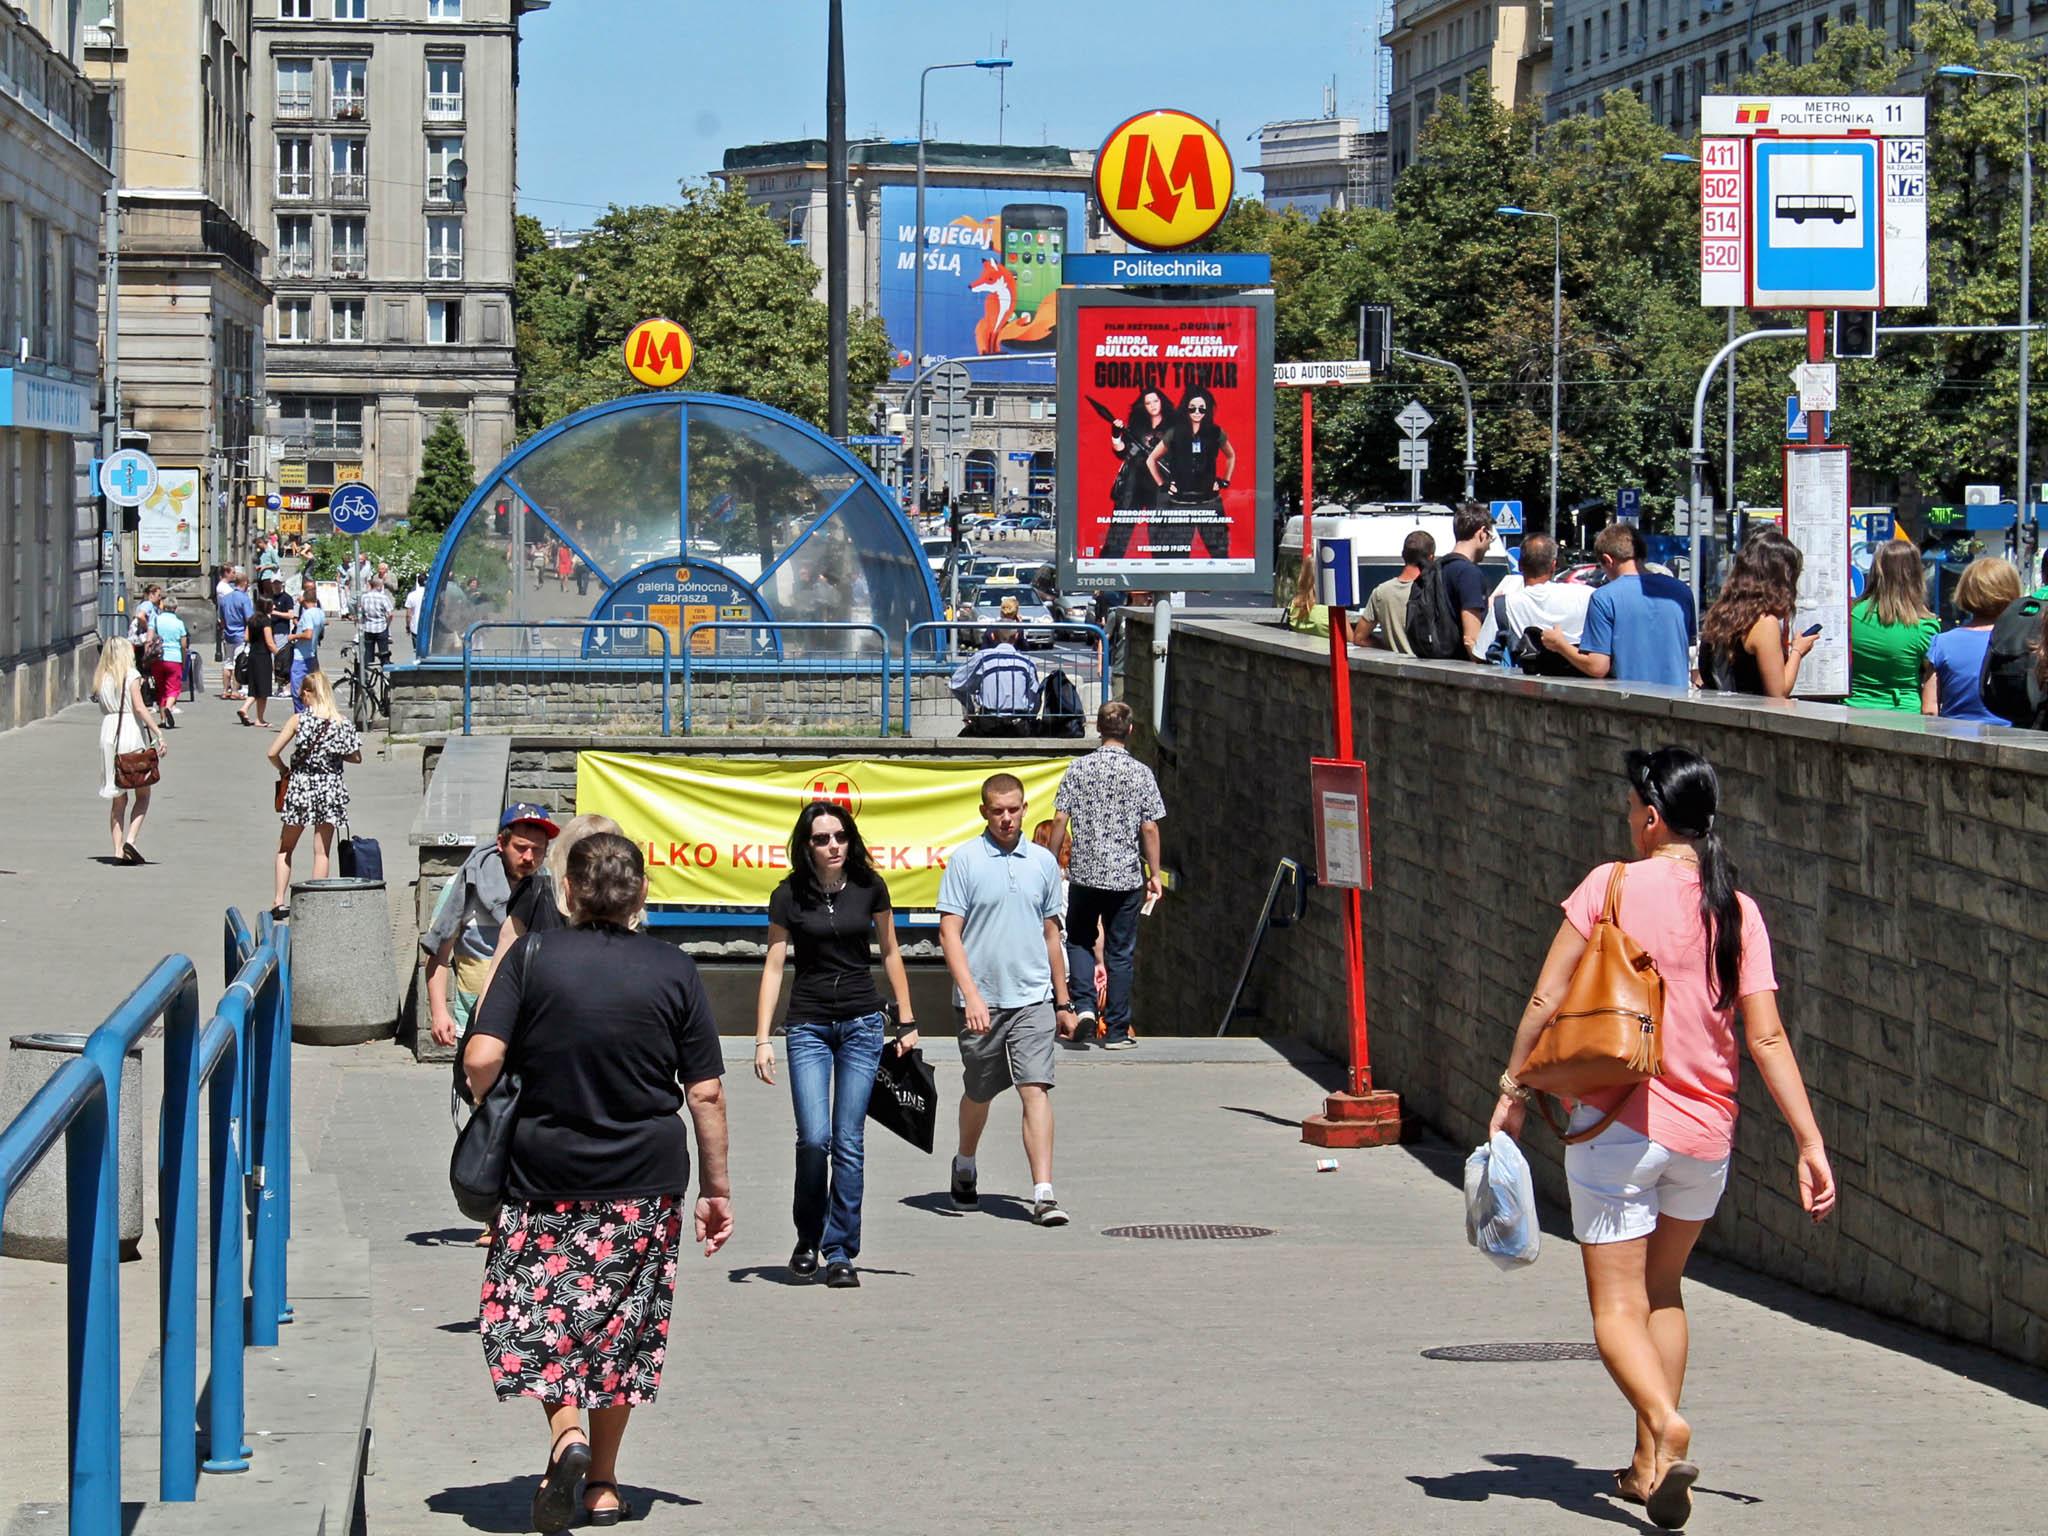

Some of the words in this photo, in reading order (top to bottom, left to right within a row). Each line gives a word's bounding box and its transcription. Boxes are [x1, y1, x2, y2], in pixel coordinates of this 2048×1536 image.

[1805, 102, 1850, 111] METRO
[1885, 105, 1902, 122] 11
[1781, 114, 1874, 124] POLITECHNIKA
[1706, 145, 1734, 166] 411
[1887, 142, 1923, 163] N25
[1705, 178, 1737, 198] 502
[1888, 175, 1923, 196] N75
[1705, 212, 1736, 232] 514
[1705, 246, 1737, 266] 520
[1113, 260, 1222, 277] Politechnika
[1106, 336, 1148, 345] SANDRA
[1180, 336, 1222, 345] MELISSA
[1095, 345, 1158, 357] BULLOCK
[1165, 345, 1238, 357] McCARTHY
[1173, 362, 1237, 388] TOWAR
[1273, 366, 1296, 380] ZOŁO
[637, 583, 675, 593] galeria
[678, 582, 728, 593] północna
[657, 594, 708, 604] zaprasza
[647, 841, 718, 867] LKO
